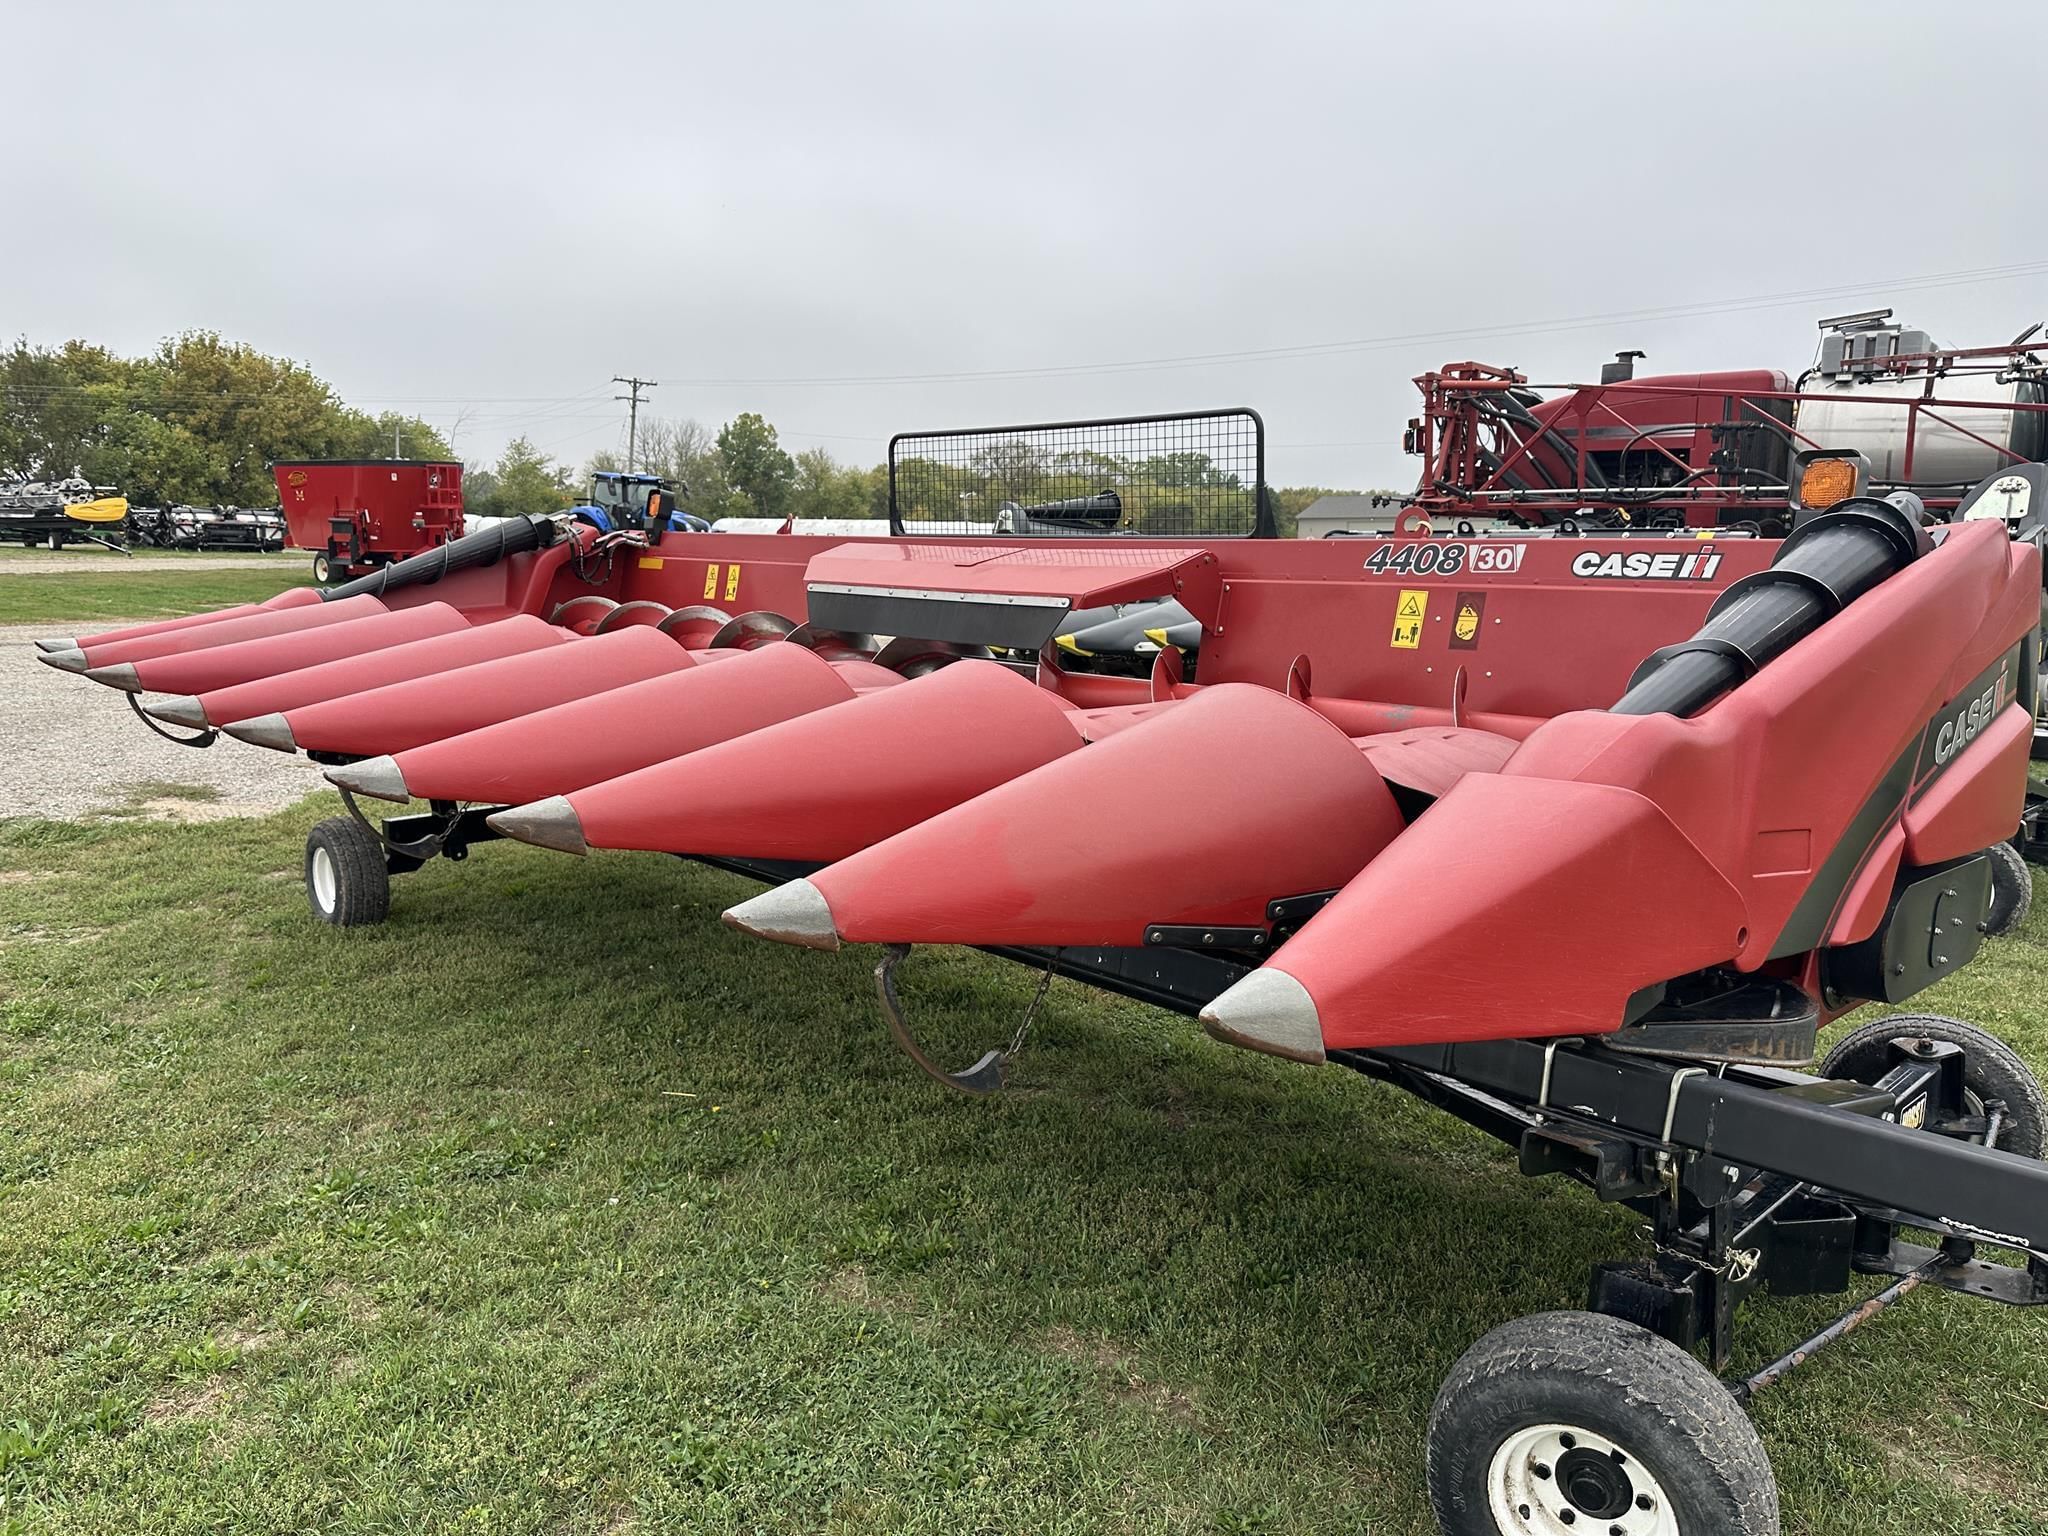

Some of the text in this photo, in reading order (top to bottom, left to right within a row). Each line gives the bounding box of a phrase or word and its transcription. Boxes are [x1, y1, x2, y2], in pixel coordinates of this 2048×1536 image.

[1364, 543, 1514, 576] 4408 30
[1571, 551, 1681, 578] CASE
[1935, 685, 1994, 765] CASE
